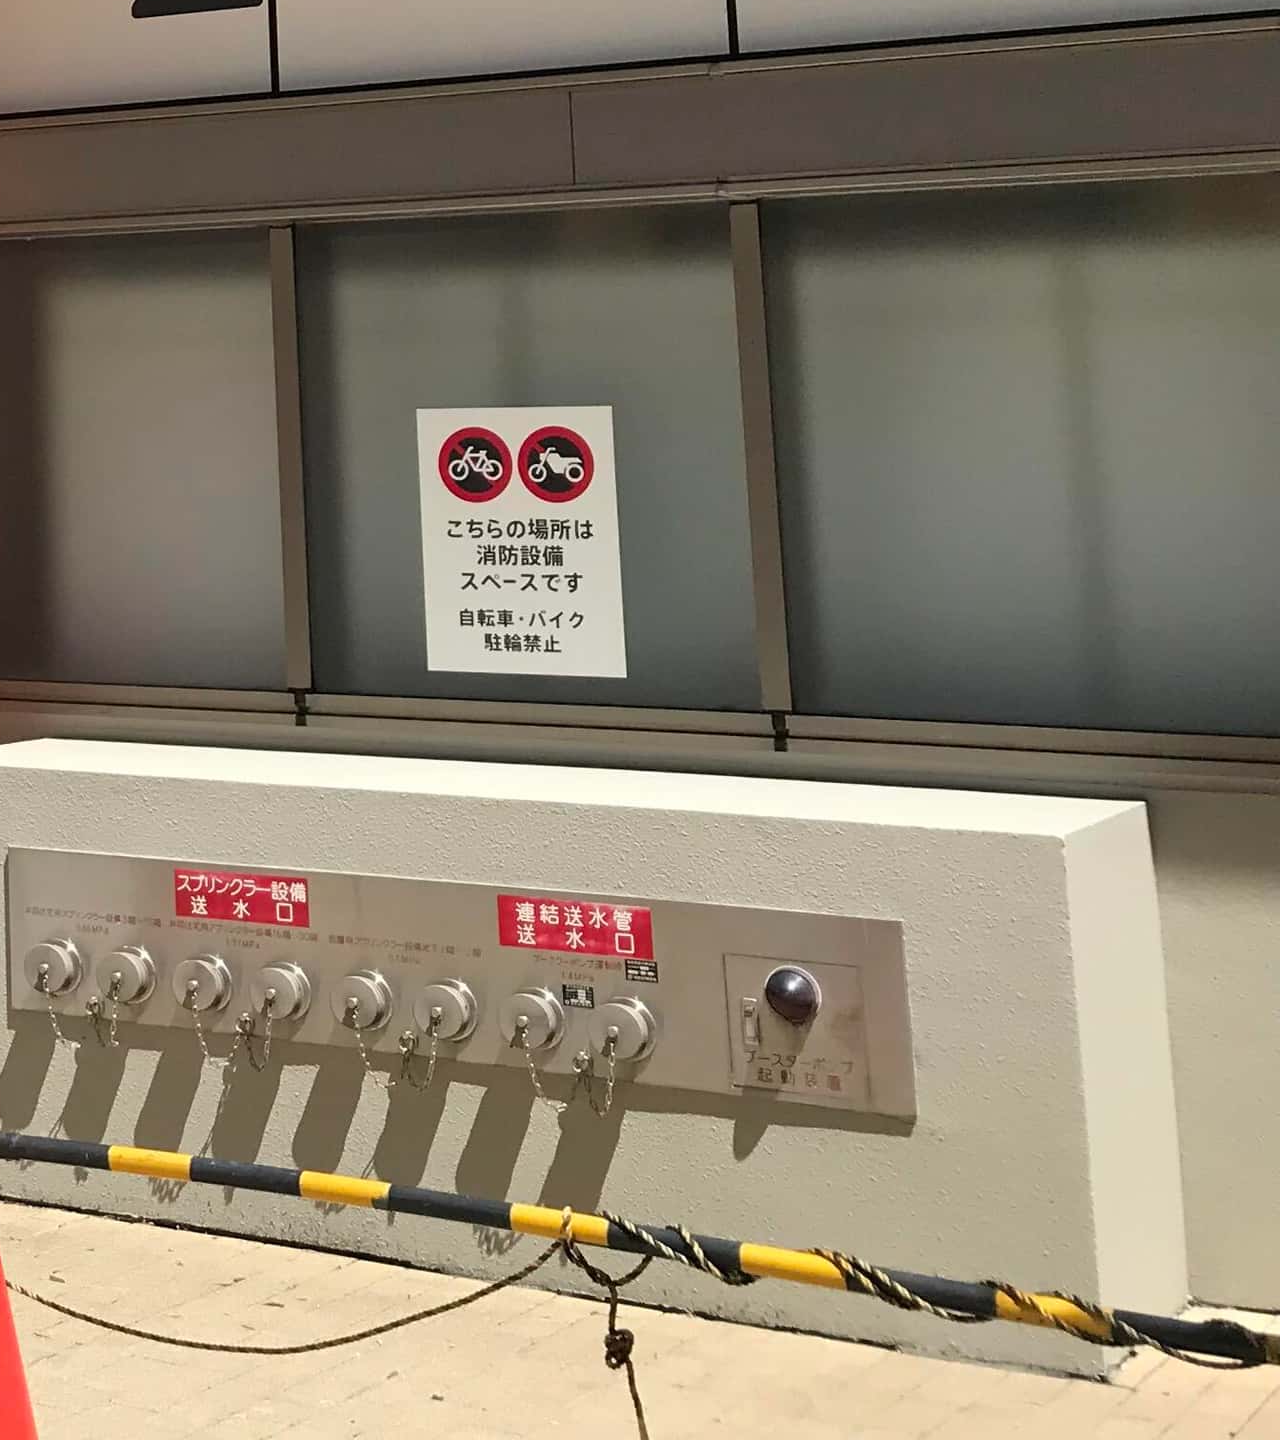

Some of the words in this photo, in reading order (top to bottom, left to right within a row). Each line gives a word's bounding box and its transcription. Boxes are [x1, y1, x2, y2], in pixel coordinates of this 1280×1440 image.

[447, 518, 594, 540] こちらの場所は
[476, 544, 564, 566] 消防設備
[461, 572, 583, 592] スペースです
[459, 608, 585, 629] 自転車・バイク
[484, 633, 562, 653] 駐輪禁止
[176, 873, 307, 903] スプリンクラー設備
[190, 895, 293, 923] 送水口
[515, 902, 633, 932] 連結送水管
[517, 924, 635, 954] 送水口
